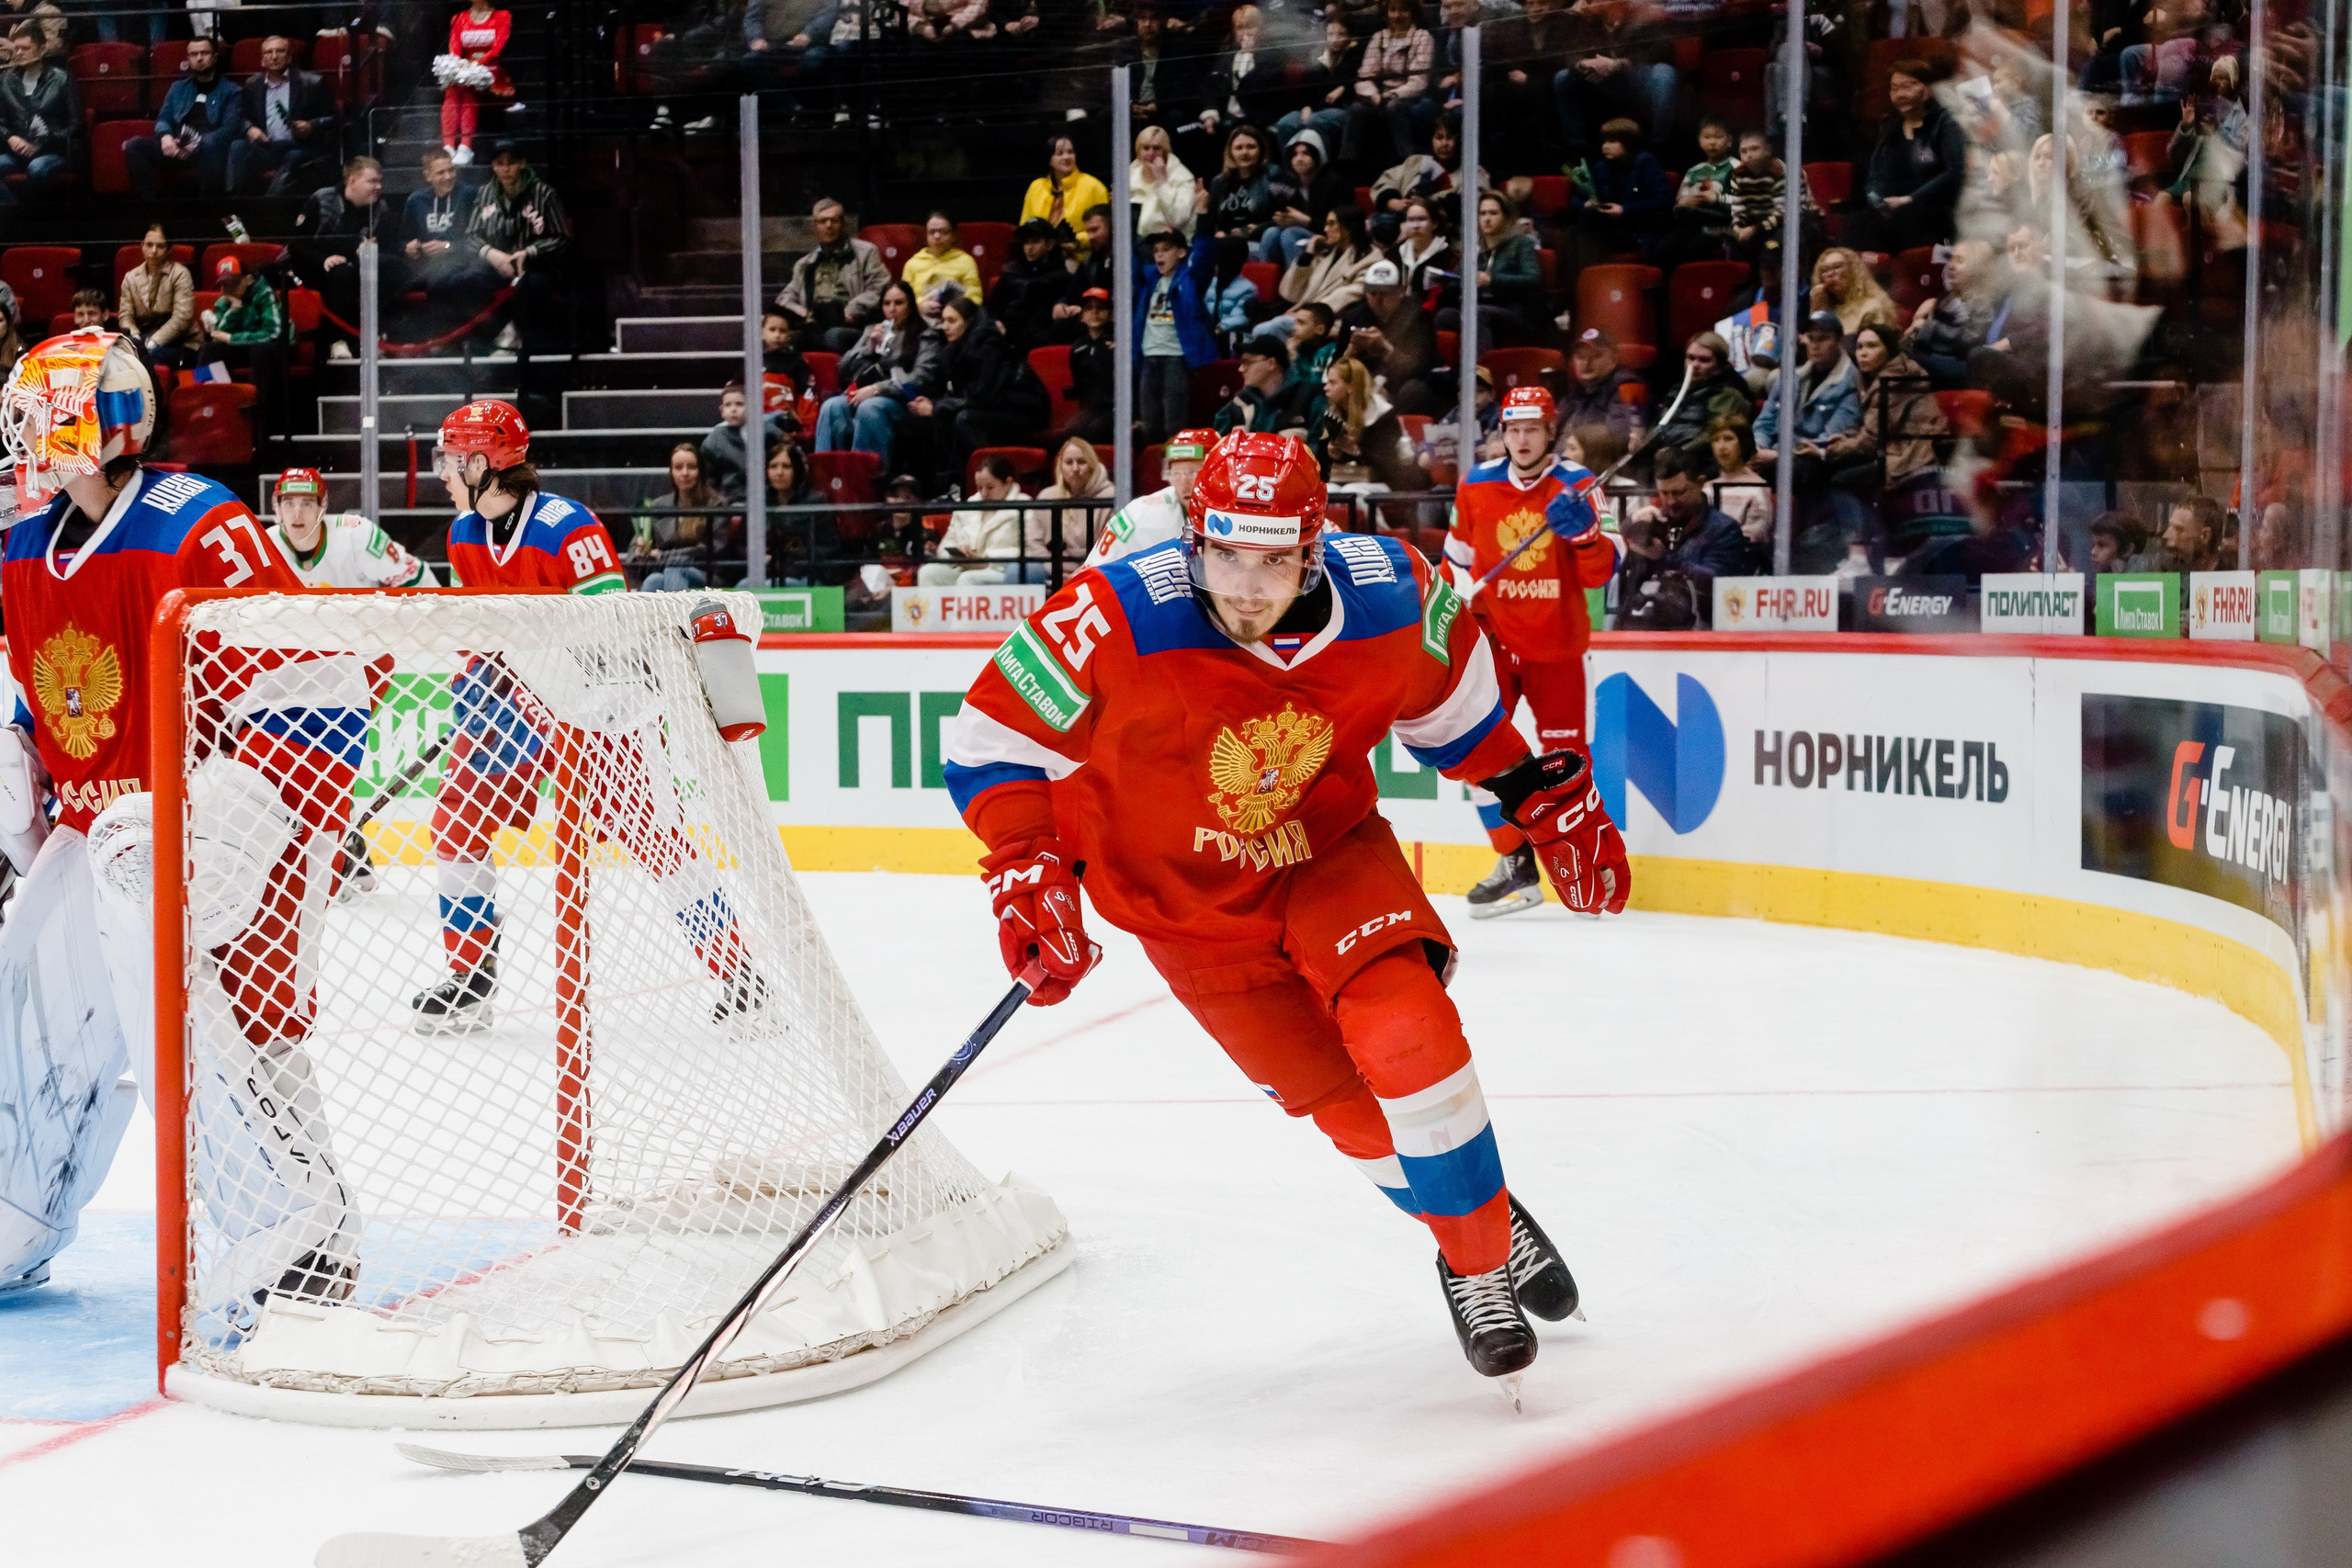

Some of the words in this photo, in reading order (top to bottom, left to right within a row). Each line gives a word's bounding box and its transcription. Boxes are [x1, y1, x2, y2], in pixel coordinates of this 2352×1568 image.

[1237, 473, 1278, 502] 25
[1238, 524, 1297, 536] НОРНИКЕЛЬ
[199, 513, 272, 589] 37
[567, 535, 613, 579] 84
[1498, 578, 1561, 599] РОССИЯ
[1756, 588, 1830, 618] FHR.RU
[1987, 591, 2078, 617] ПОЛИПЛАСТ
[2213, 586, 2252, 624] FHRRU
[714, 615, 728, 627] 37
[941, 595, 1035, 622] FHR.RU
[1041, 581, 1113, 673] 25
[1436, 612, 1453, 647] ЛИГА
[997, 645, 1025, 682] ЛИГА
[1018, 672, 1068, 727] СТАВОК
[1543, 760, 1563, 772] CCM
[1754, 729, 2009, 804] НОРНИКЕЛЬ
[55, 777, 144, 815] ССИЯ
[986, 864, 1045, 904] CM
[1066, 931, 1080, 963] CCM
[1334, 910, 1412, 955] CCM
[1031, 1509, 1114, 1532] RIBCOR
